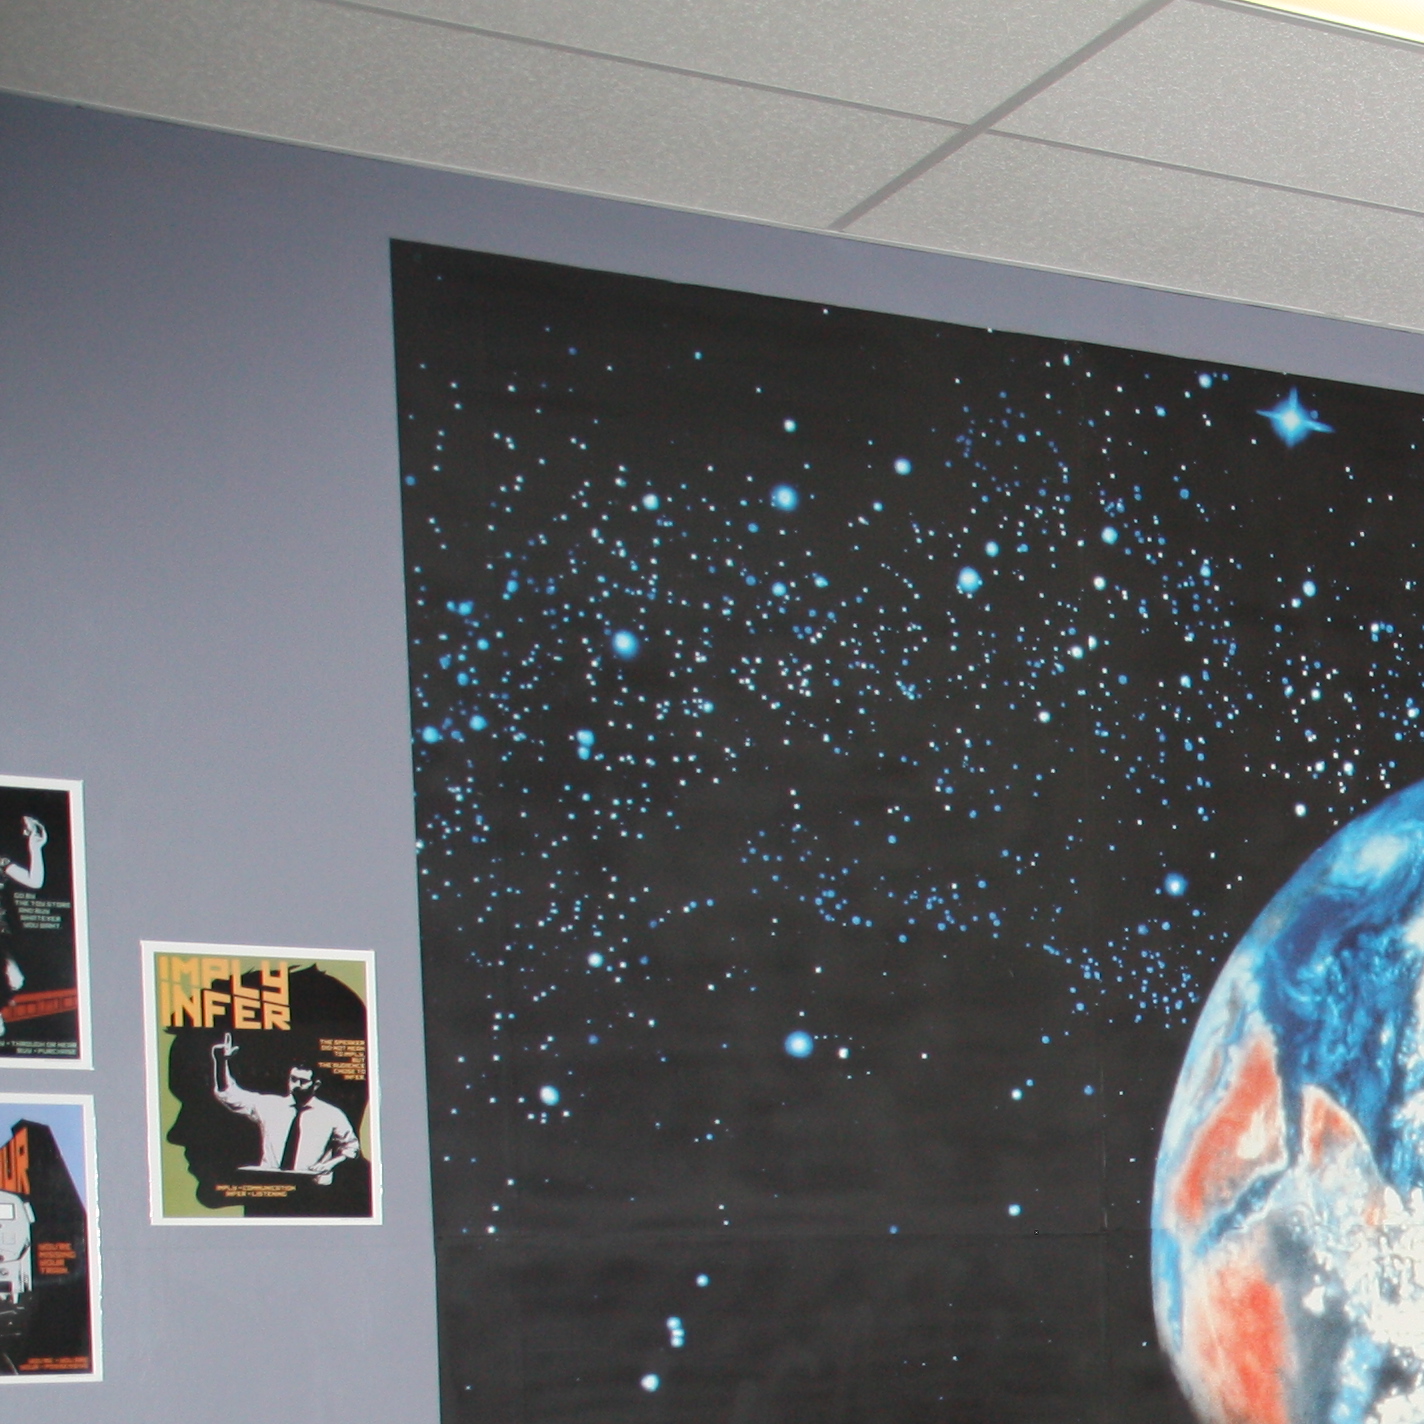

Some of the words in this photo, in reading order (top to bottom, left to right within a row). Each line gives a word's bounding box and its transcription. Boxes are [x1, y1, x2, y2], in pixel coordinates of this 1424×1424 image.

[158, 956, 289, 1006] IMPLY
[160, 979, 291, 1030] INFER
[0, 1126, 30, 1195] UR
